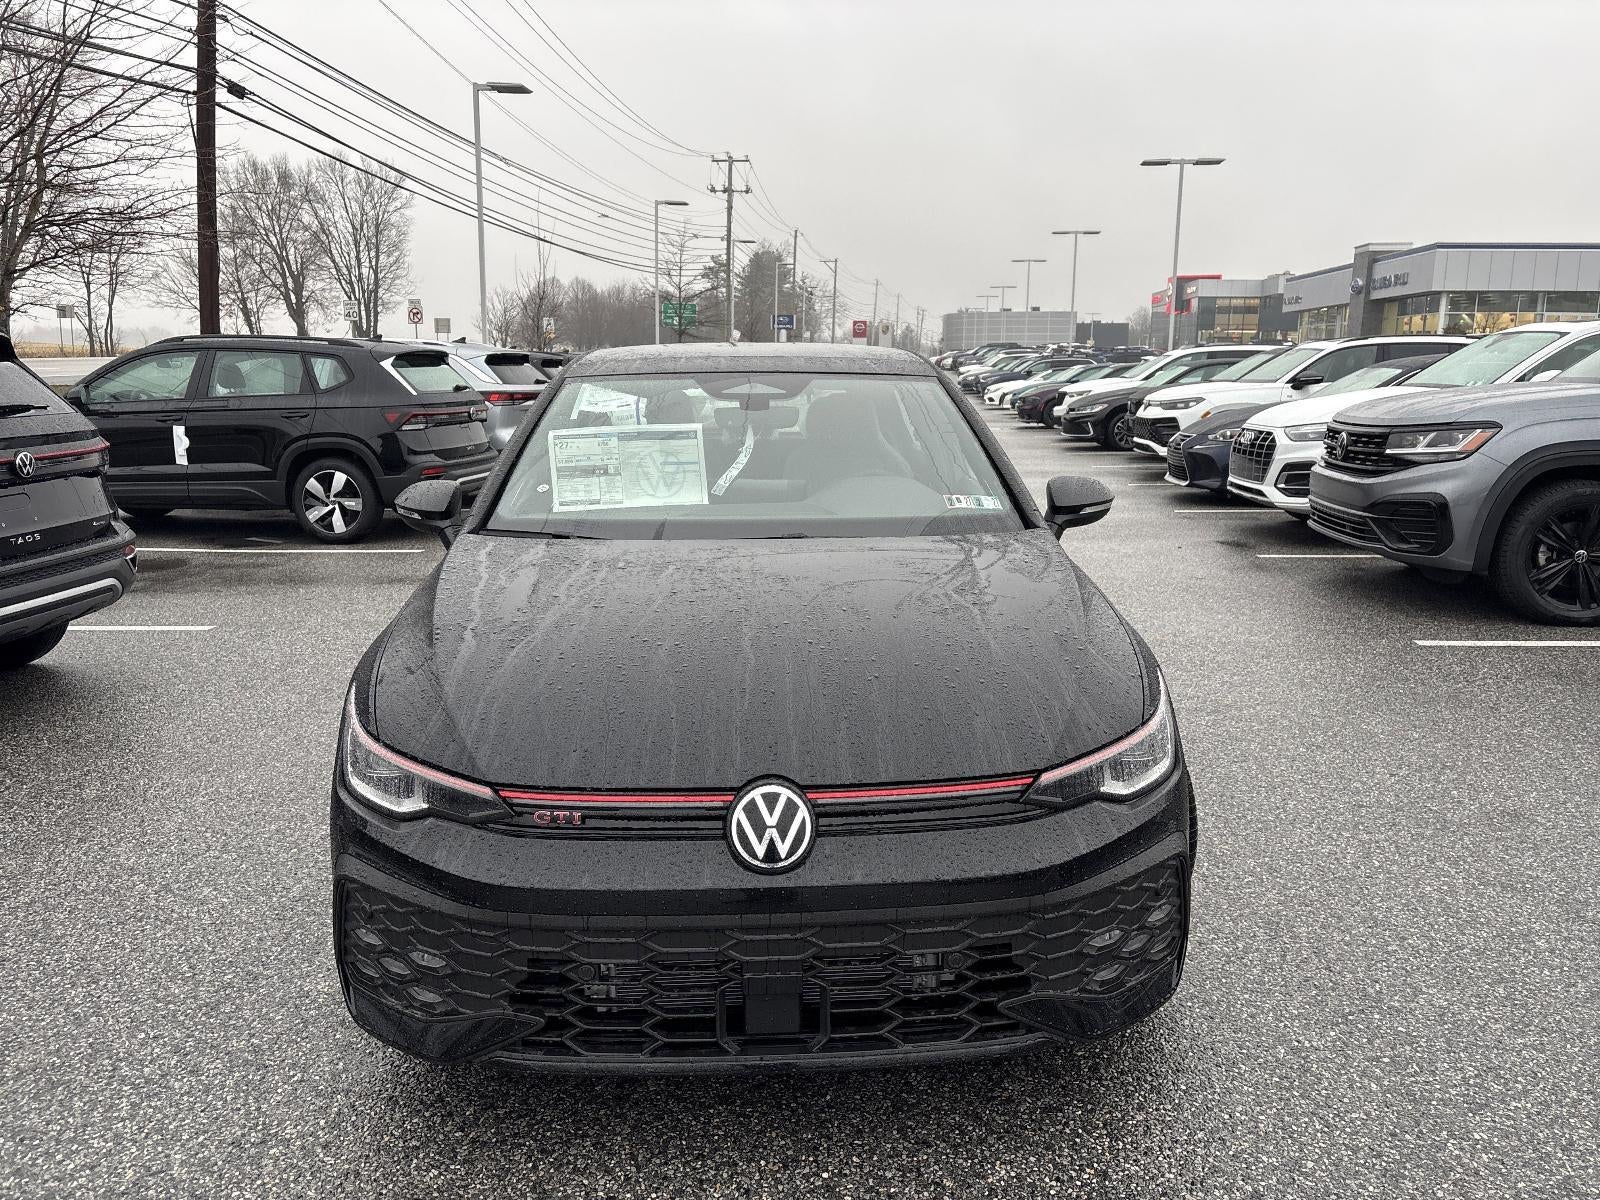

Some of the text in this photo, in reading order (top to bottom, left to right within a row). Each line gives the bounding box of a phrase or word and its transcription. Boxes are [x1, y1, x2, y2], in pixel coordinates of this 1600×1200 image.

[345, 310, 358, 319] 40
[9, 533, 41, 546] TAOS
[533, 810, 582, 825] GTI
